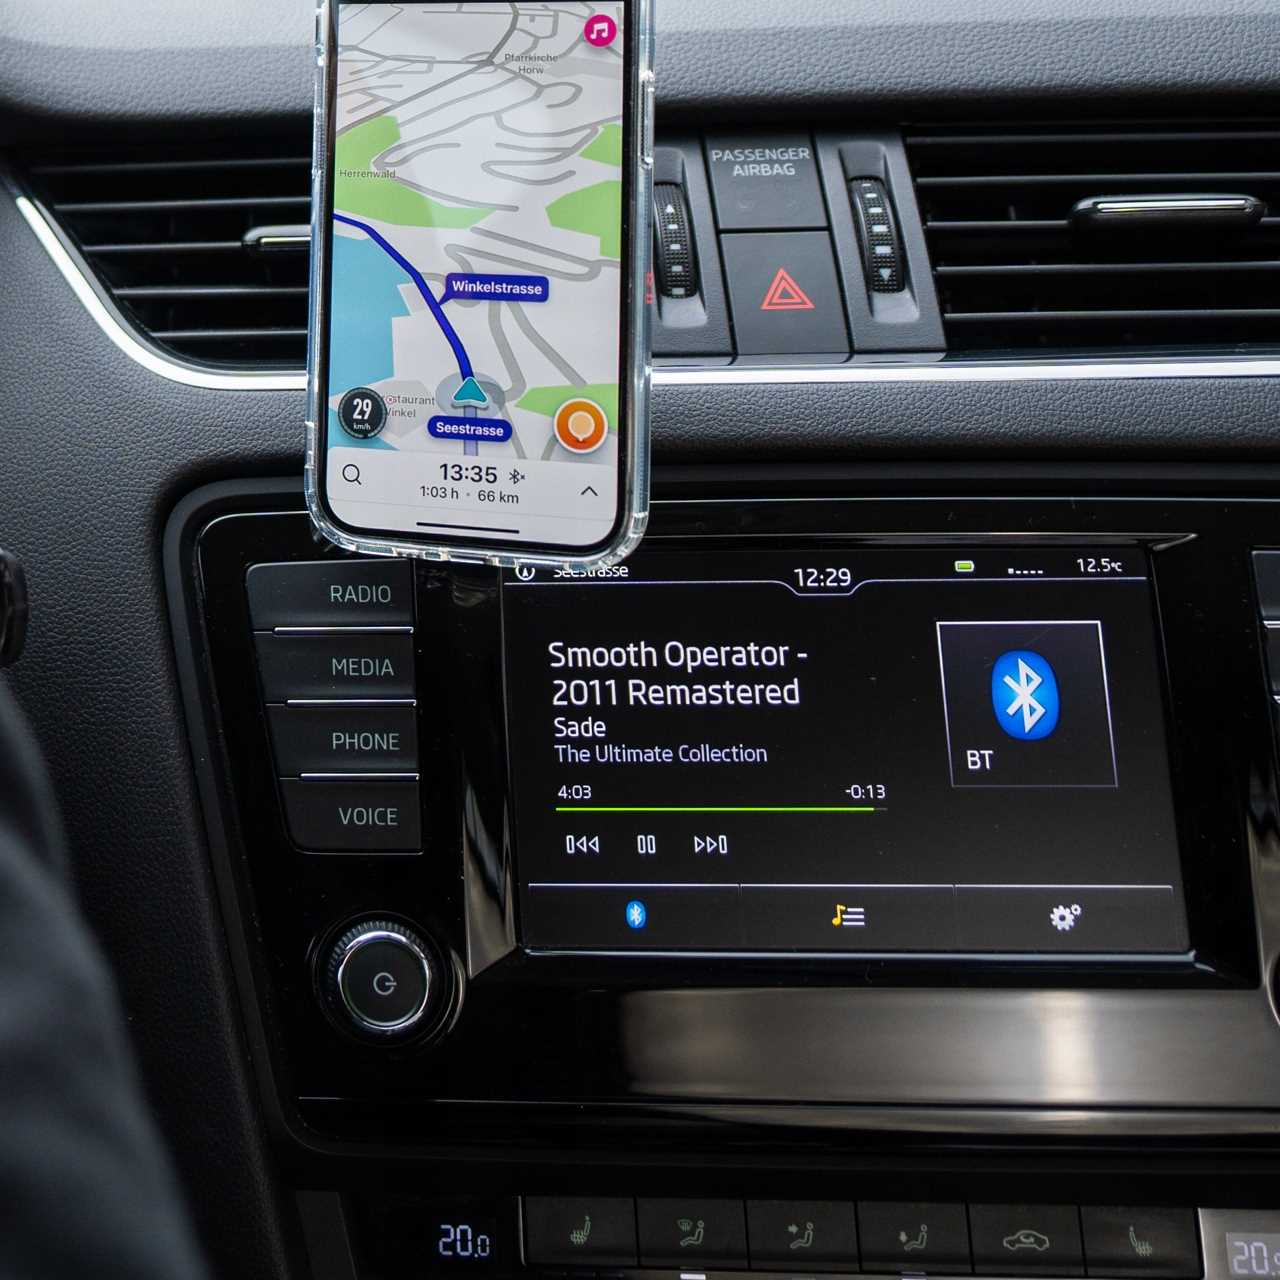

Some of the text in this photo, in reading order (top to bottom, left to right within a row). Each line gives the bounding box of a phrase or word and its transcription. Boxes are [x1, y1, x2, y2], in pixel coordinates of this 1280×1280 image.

[711, 147, 811, 161] PASSENGER
[733, 163, 795, 176] AIRBAG
[452, 280, 542, 295] Winkelstrasse
[353, 399, 371, 419] 29
[436, 422, 504, 437] Seestrasse
[440, 464, 497, 483] 13:35
[420, 486, 518, 504] 1:03 h 66 km
[794, 567, 852, 587] 12:29
[331, 585, 390, 602] RADIO
[549, 641, 657, 667] Smooth
[665, 641, 789, 673] Operator
[333, 658, 394, 676] MEDIA
[553, 678, 799, 705] 2011 Remastered
[554, 717, 606, 737] Sade
[333, 733, 399, 750] PHONE
[554, 744, 767, 762] The Ultimate Collection
[967, 750, 993, 769] BT
[558, 785, 591, 798] 4:03
[846, 785, 885, 798] -0:13
[339, 808, 397, 825] VOICE
[439, 1225, 489, 1257] 20.0
